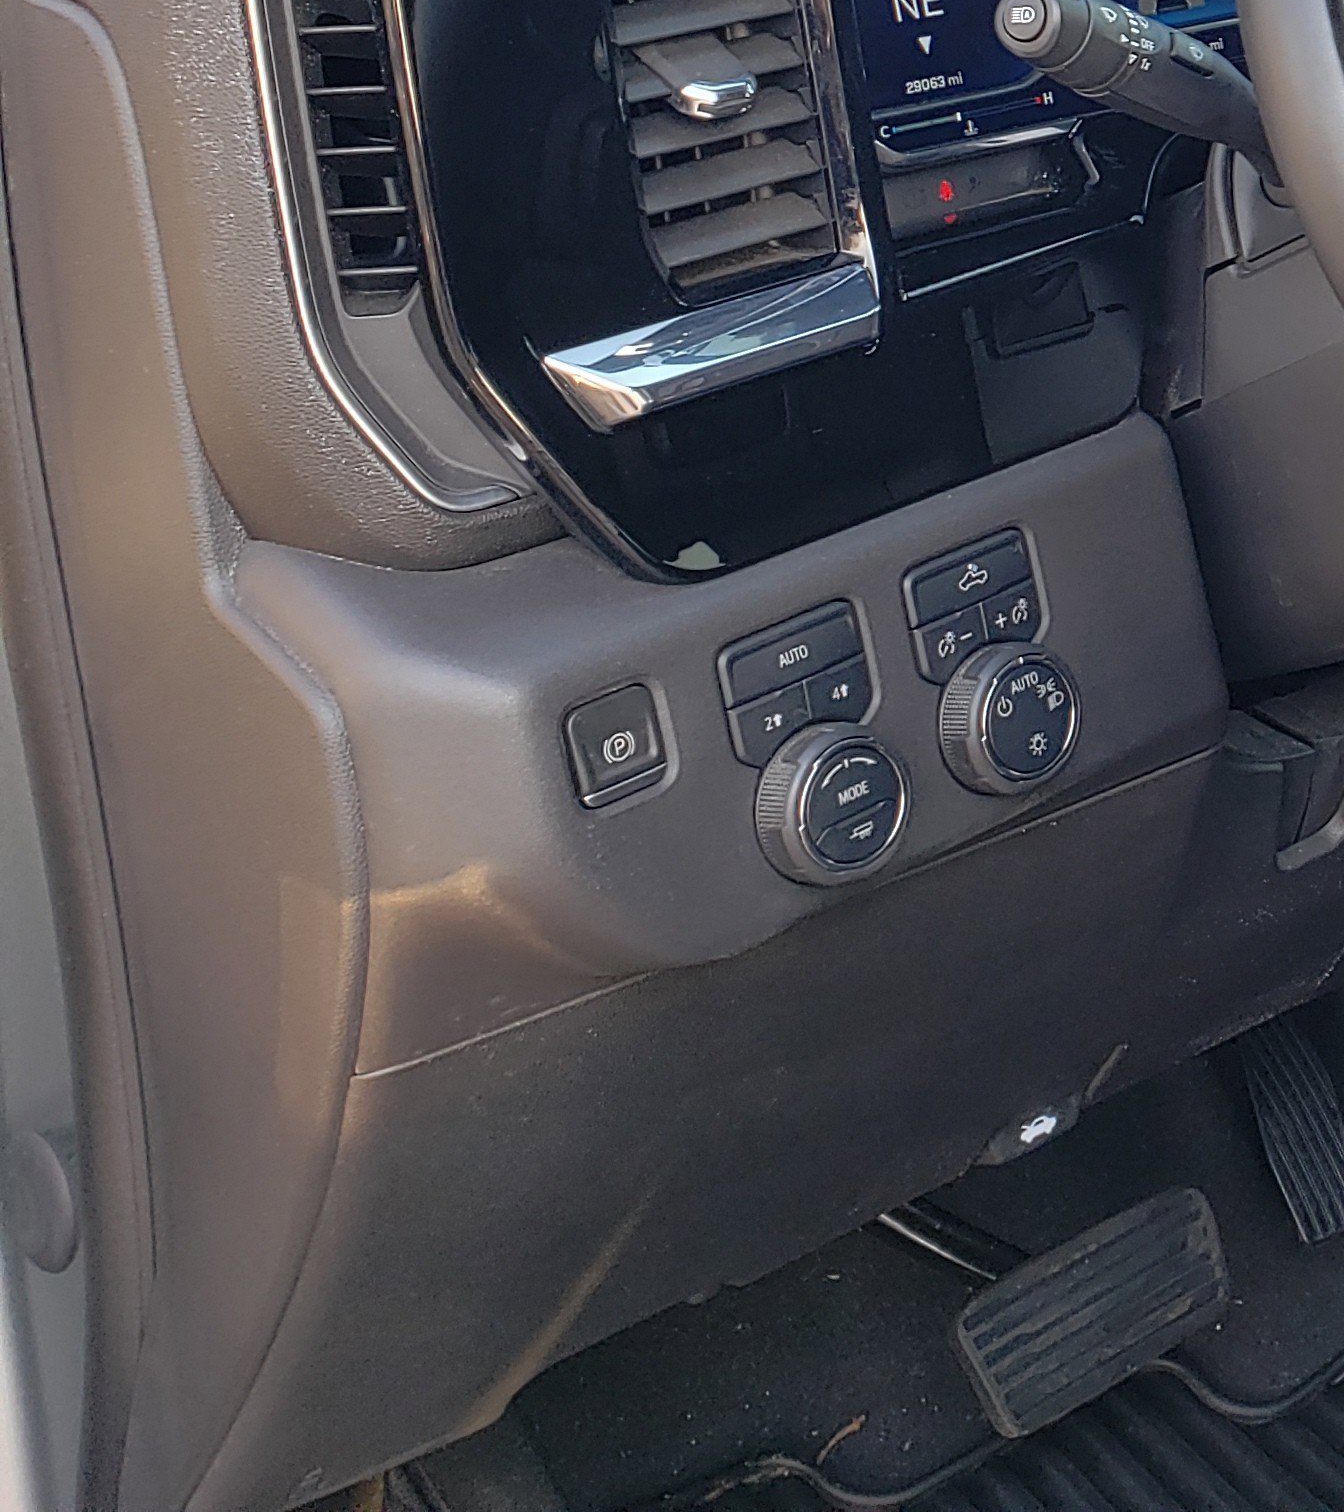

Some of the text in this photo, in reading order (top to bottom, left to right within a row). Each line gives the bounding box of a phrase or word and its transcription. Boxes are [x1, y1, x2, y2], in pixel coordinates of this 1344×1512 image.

[1140, 38, 1155, 52] OFF
[905, 70, 965, 95] 29063 mi
[1042, 91, 1054, 105] H
[879, 125, 891, 139] C
[779, 644, 809, 669] AUTO
[1011, 671, 1039, 696] AUTO
[838, 780, 870, 806] MODE
